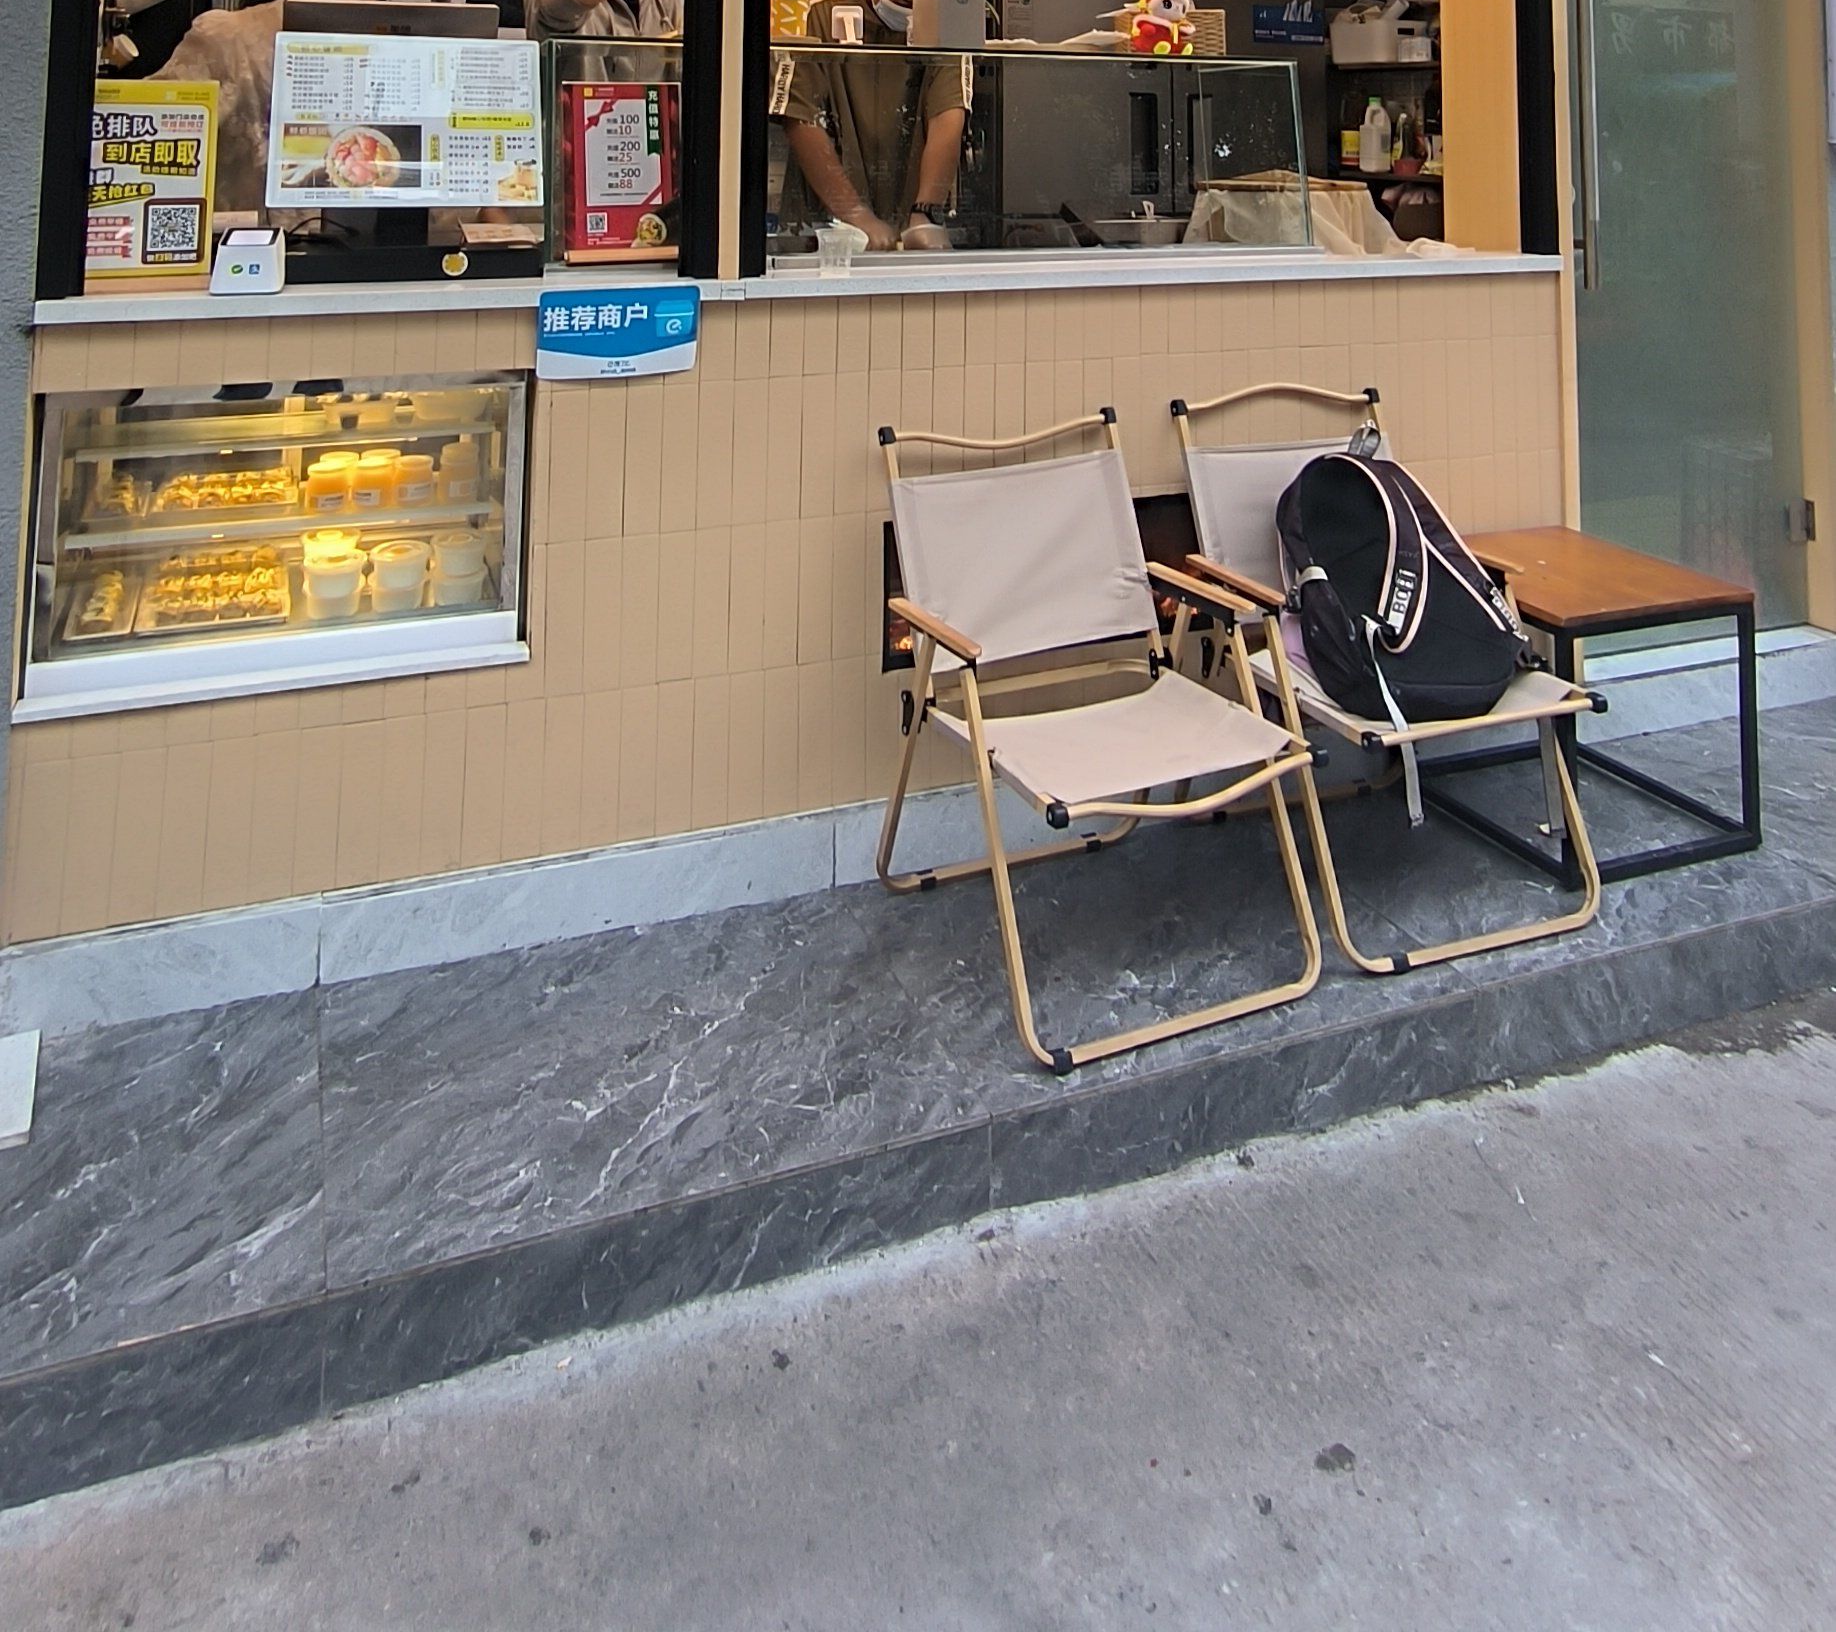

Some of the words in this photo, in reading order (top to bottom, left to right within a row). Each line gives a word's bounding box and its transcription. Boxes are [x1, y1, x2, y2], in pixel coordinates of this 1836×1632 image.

[620, 114, 640, 125] 100
[105, 141, 199, 166] 到店即取
[620, 141, 641, 152] 200
[620, 168, 641, 178] 500
[88, 183, 154, 202] 天抢红包
[543, 303, 648, 332] 推荐商户
